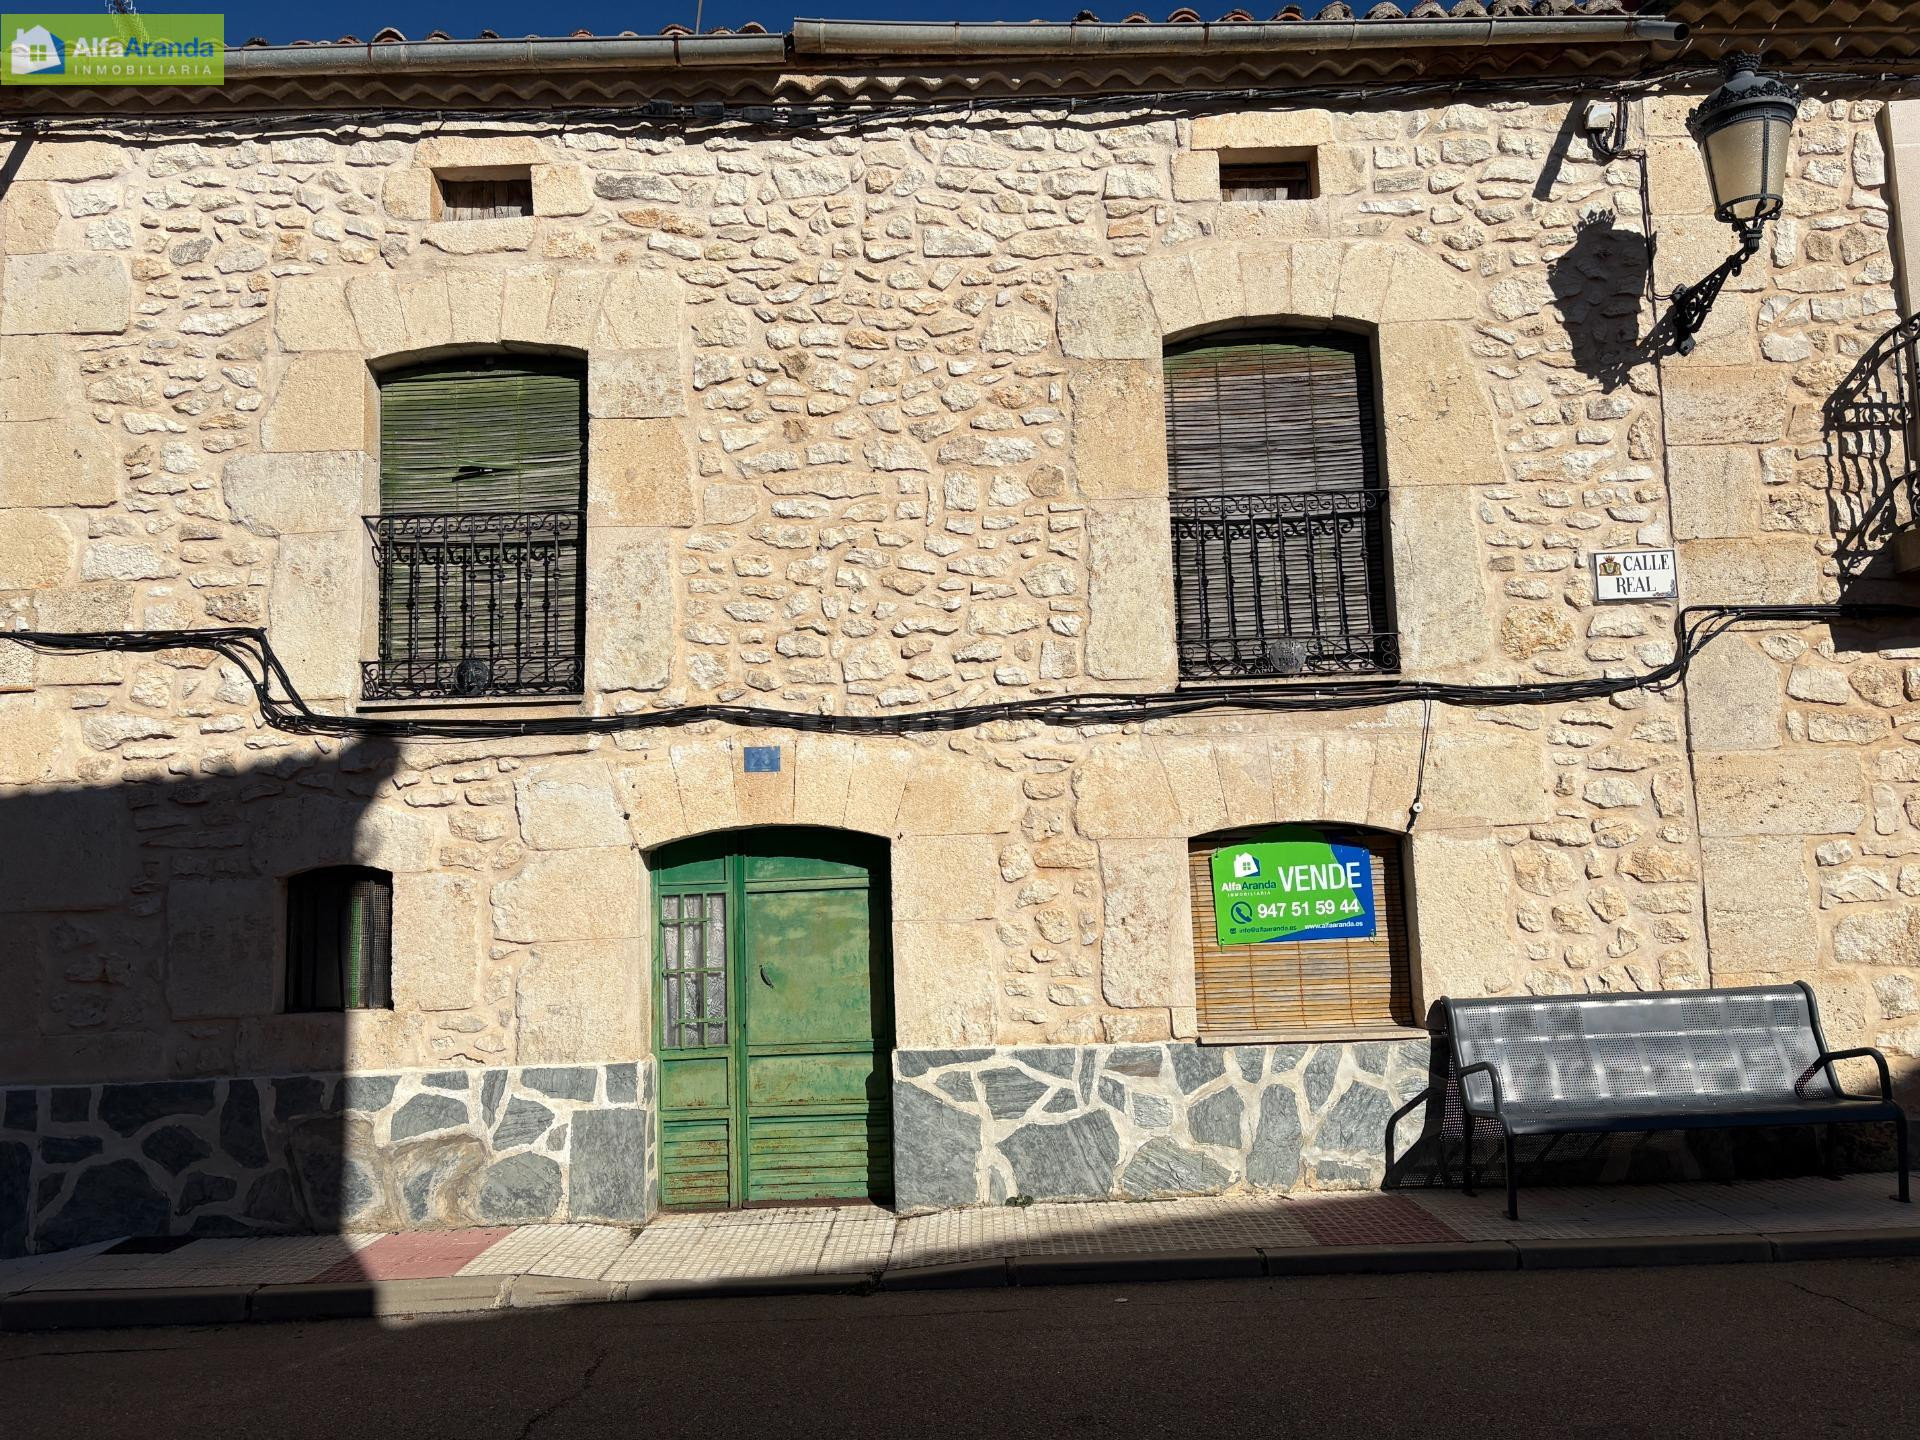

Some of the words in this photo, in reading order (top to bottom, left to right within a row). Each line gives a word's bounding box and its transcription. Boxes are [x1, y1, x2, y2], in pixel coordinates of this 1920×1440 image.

[1623, 553, 1669, 571] CALLE
[1616, 576, 1657, 595] REAL
[1221, 880, 1276, 892] AlfaAranda
[1278, 862, 1362, 893] VENDE
[1257, 902, 1287, 919] 947
[1291, 901, 1309, 917] 51
[1315, 899, 1335, 915] 59
[1340, 898, 1360, 914] 44
